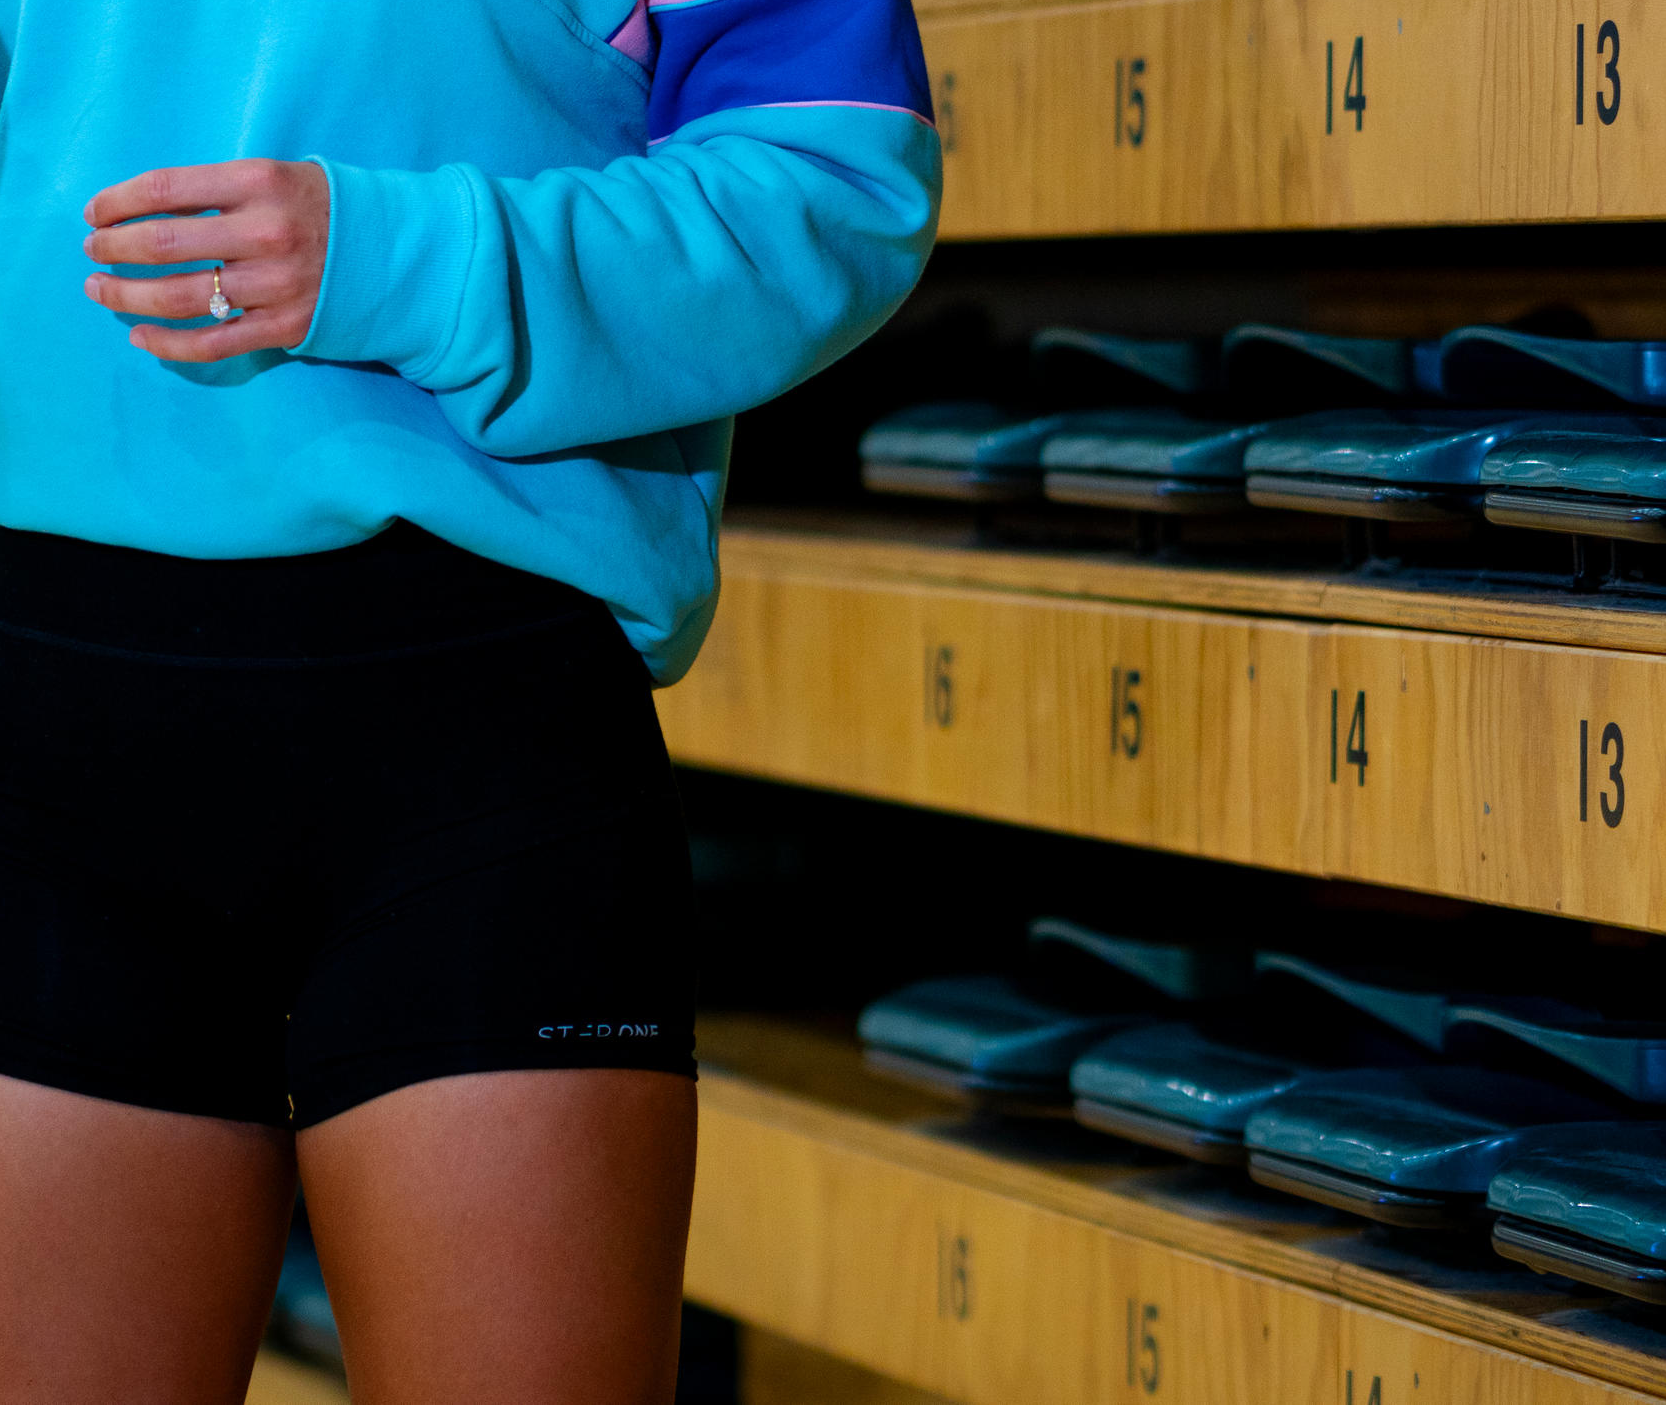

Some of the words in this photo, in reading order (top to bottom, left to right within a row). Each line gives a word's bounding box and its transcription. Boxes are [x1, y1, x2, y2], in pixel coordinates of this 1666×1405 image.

[1116, 58, 1146, 147] 15
[1326, 36, 1366, 134] 14
[1576, 20, 1621, 125] 13
[924, 645, 954, 728] 16
[1112, 669, 1142, 758] 15
[1331, 690, 1368, 786] 14
[1580, 720, 1624, 828] 13
[940, 1236, 970, 1321] 16
[1128, 1301, 1159, 1394] 15
